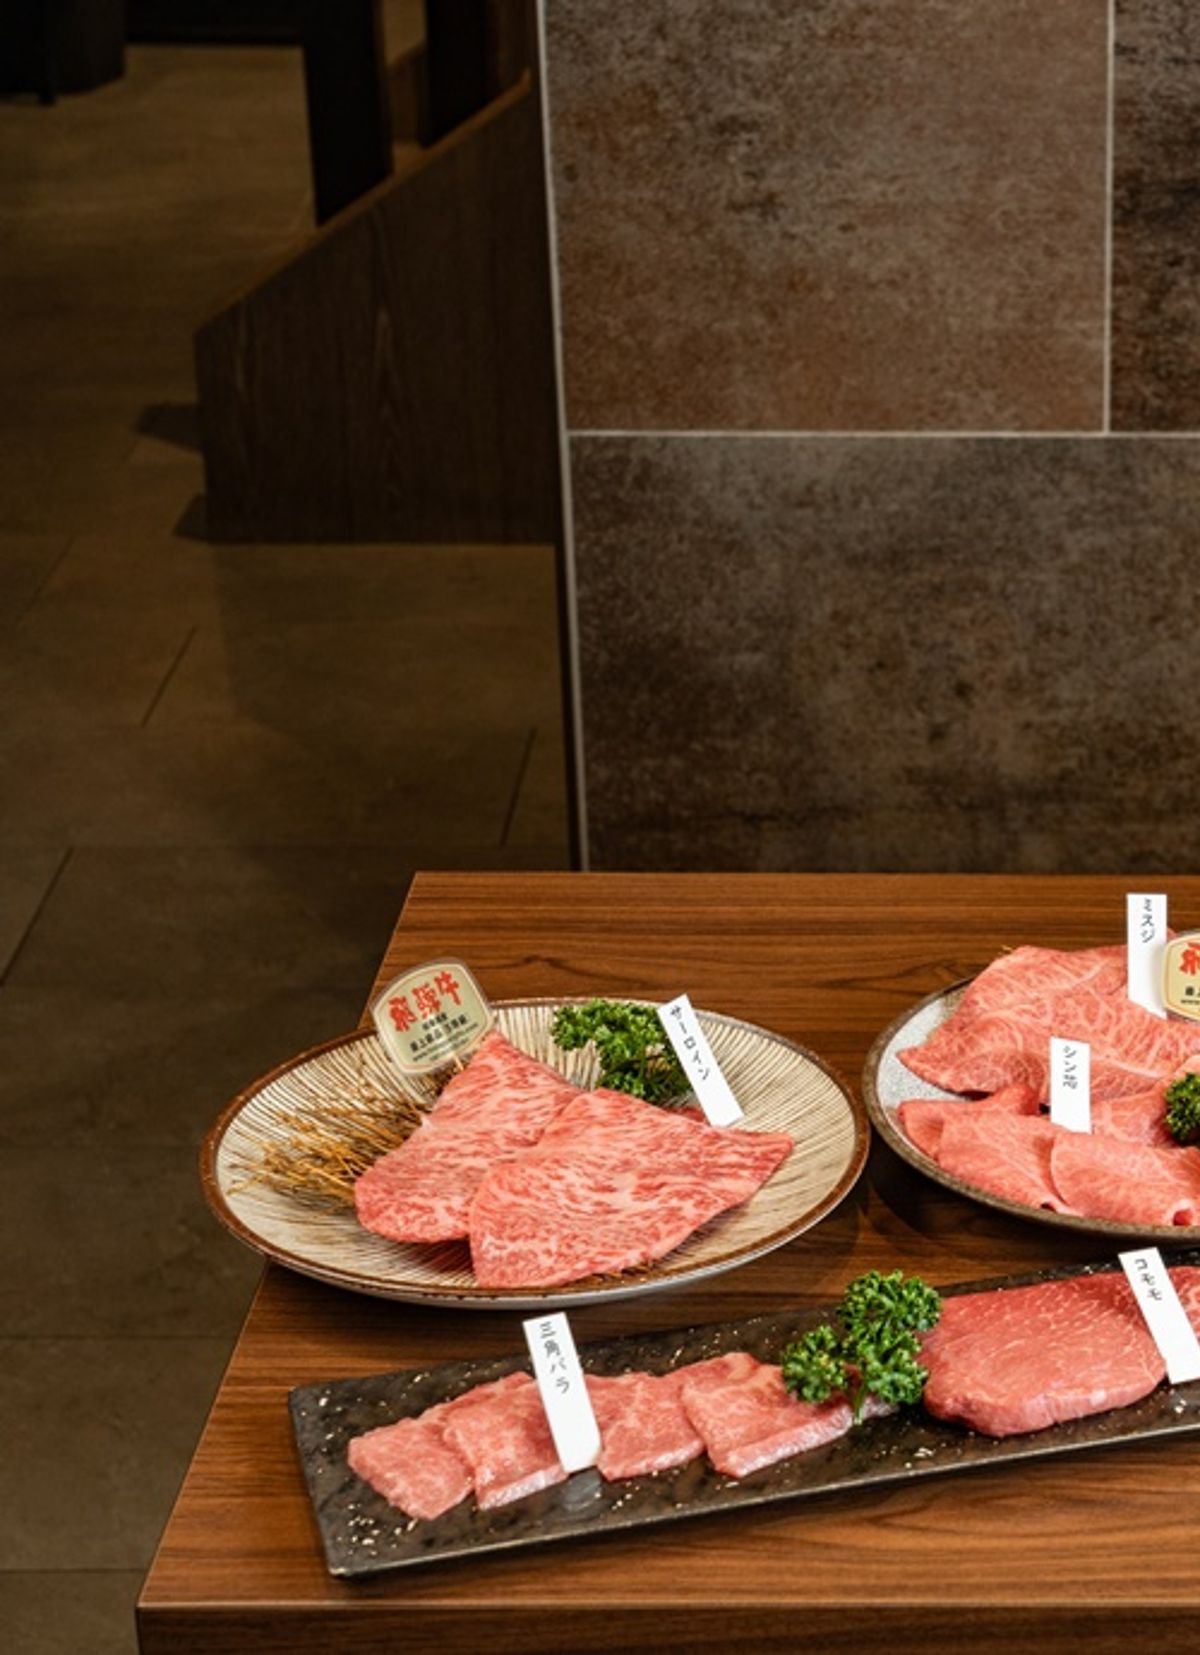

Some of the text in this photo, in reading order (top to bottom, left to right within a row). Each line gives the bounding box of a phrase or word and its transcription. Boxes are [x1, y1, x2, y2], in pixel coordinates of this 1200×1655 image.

[1141, 897, 1155, 943] ミスジ
[387, 971, 461, 1032] 飛騨牛
[670, 1005, 710, 1080] サーロイン
[1135, 1258, 1162, 1301] コモモ
[539, 1321, 570, 1394] 三角バラ
